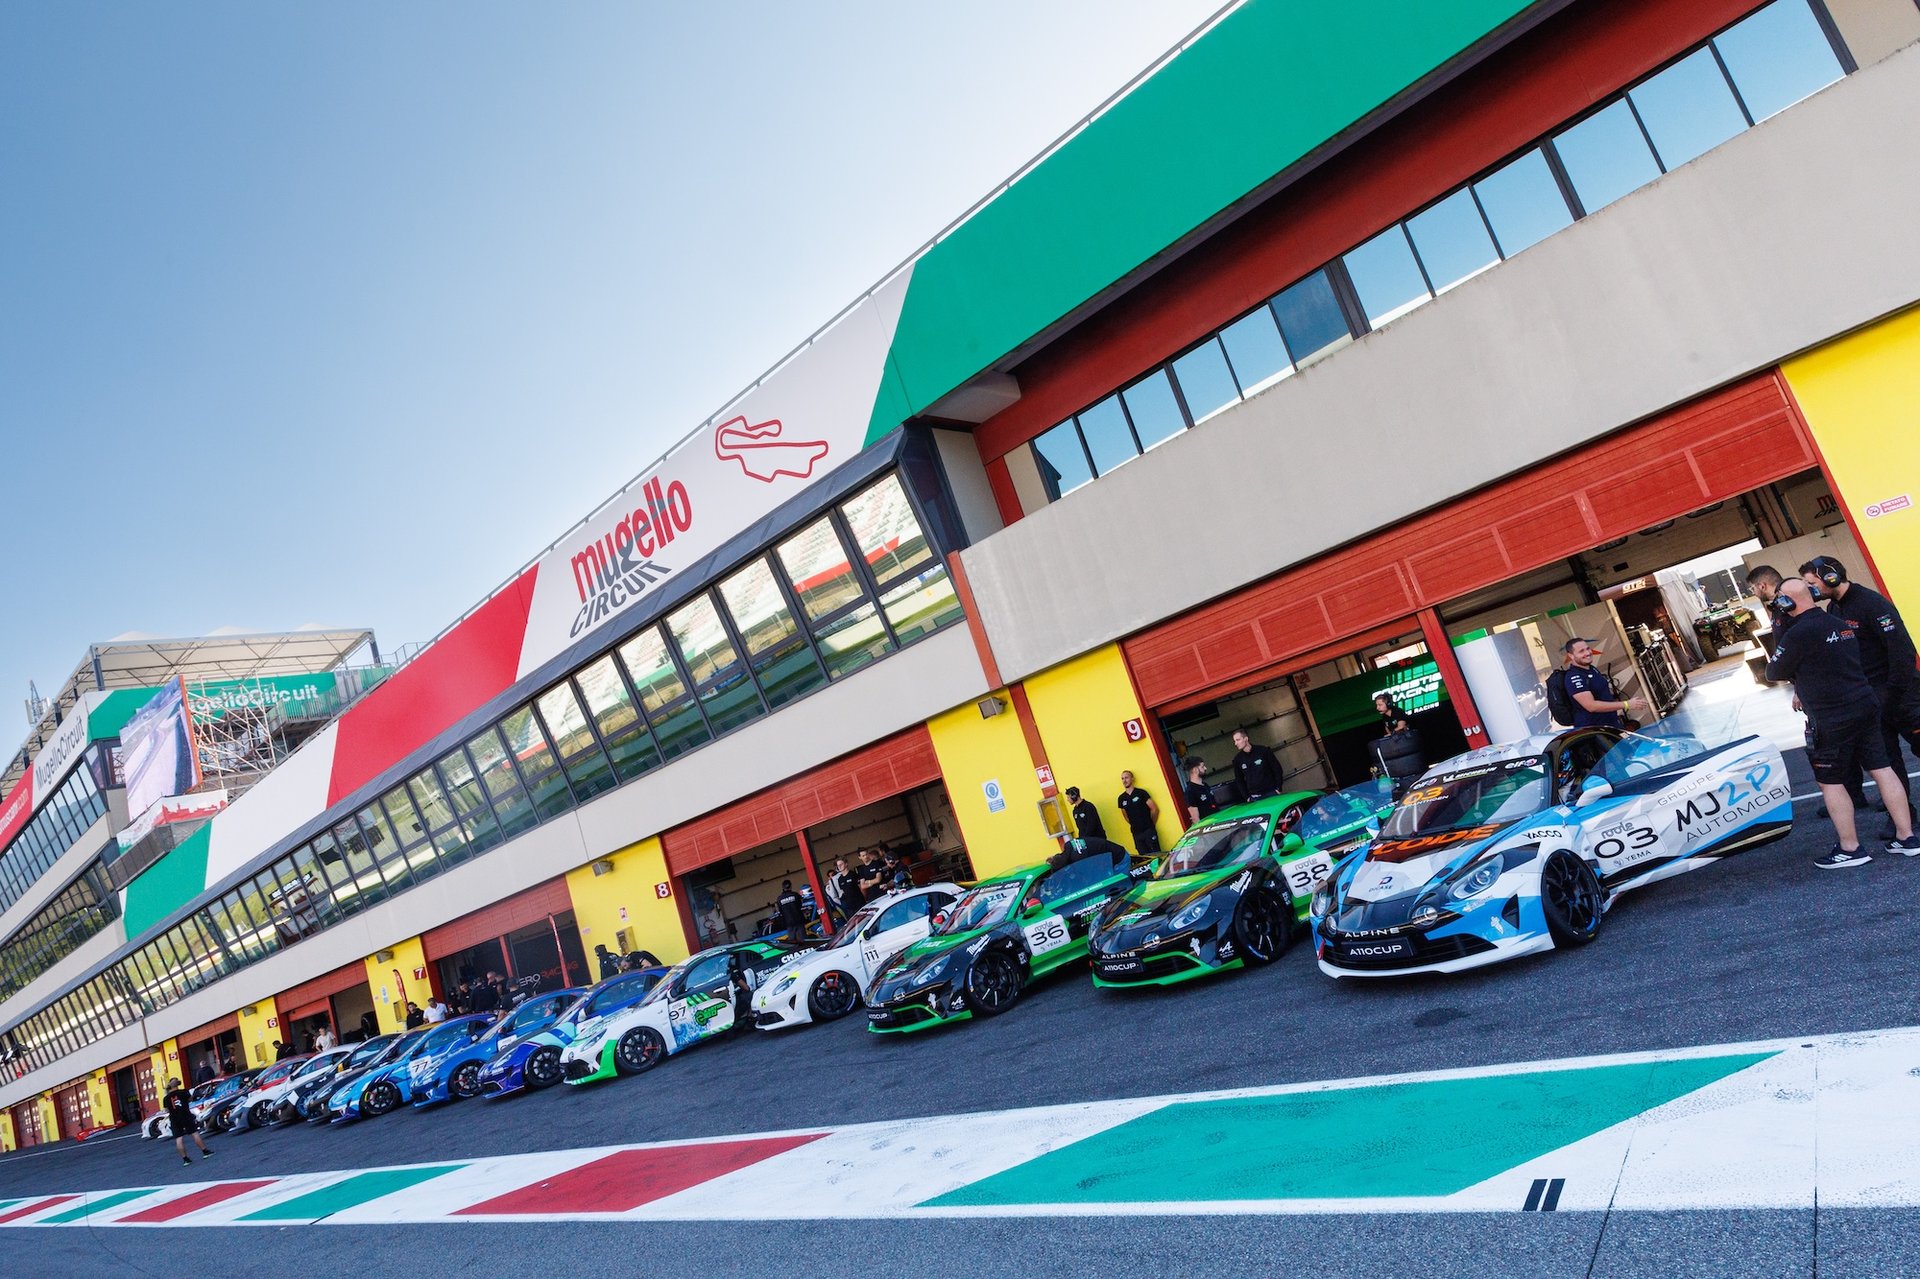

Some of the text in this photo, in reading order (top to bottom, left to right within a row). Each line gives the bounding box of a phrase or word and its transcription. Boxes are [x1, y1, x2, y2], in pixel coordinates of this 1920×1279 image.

[571, 476, 692, 604] mugello
[570, 561, 672, 639] CIRCUIT
[189, 684, 317, 711] gelloCircuit
[1127, 720, 1142, 740] 9
[36, 715, 85, 791] MugelloCircuit
[1402, 786, 1444, 805] 03
[1657, 773, 1715, 806] GROUPE
[1675, 764, 1771, 832] MJ2P
[1373, 823, 1500, 855] CODE
[1522, 830, 1562, 839] YACCO
[1594, 827, 1659, 858] 03
[1625, 849, 1652, 862] YEMA
[1291, 863, 1329, 888] 38
[657, 883, 669, 897] 8
[1031, 924, 1064, 946] 36
[1345, 927, 1400, 938] ALPINE
[864, 949, 880, 962] 111
[1102, 951, 1136, 959] ALPINE
[1350, 944, 1402, 956] A110CUP
[414, 968, 423, 979] 7
[1104, 962, 1137, 971] A110CUP
[669, 1006, 686, 1020] 97
[268, 1018, 277, 1028] 6
[169, 1053, 178, 1061] 5
[412, 1061, 428, 1073] 77
